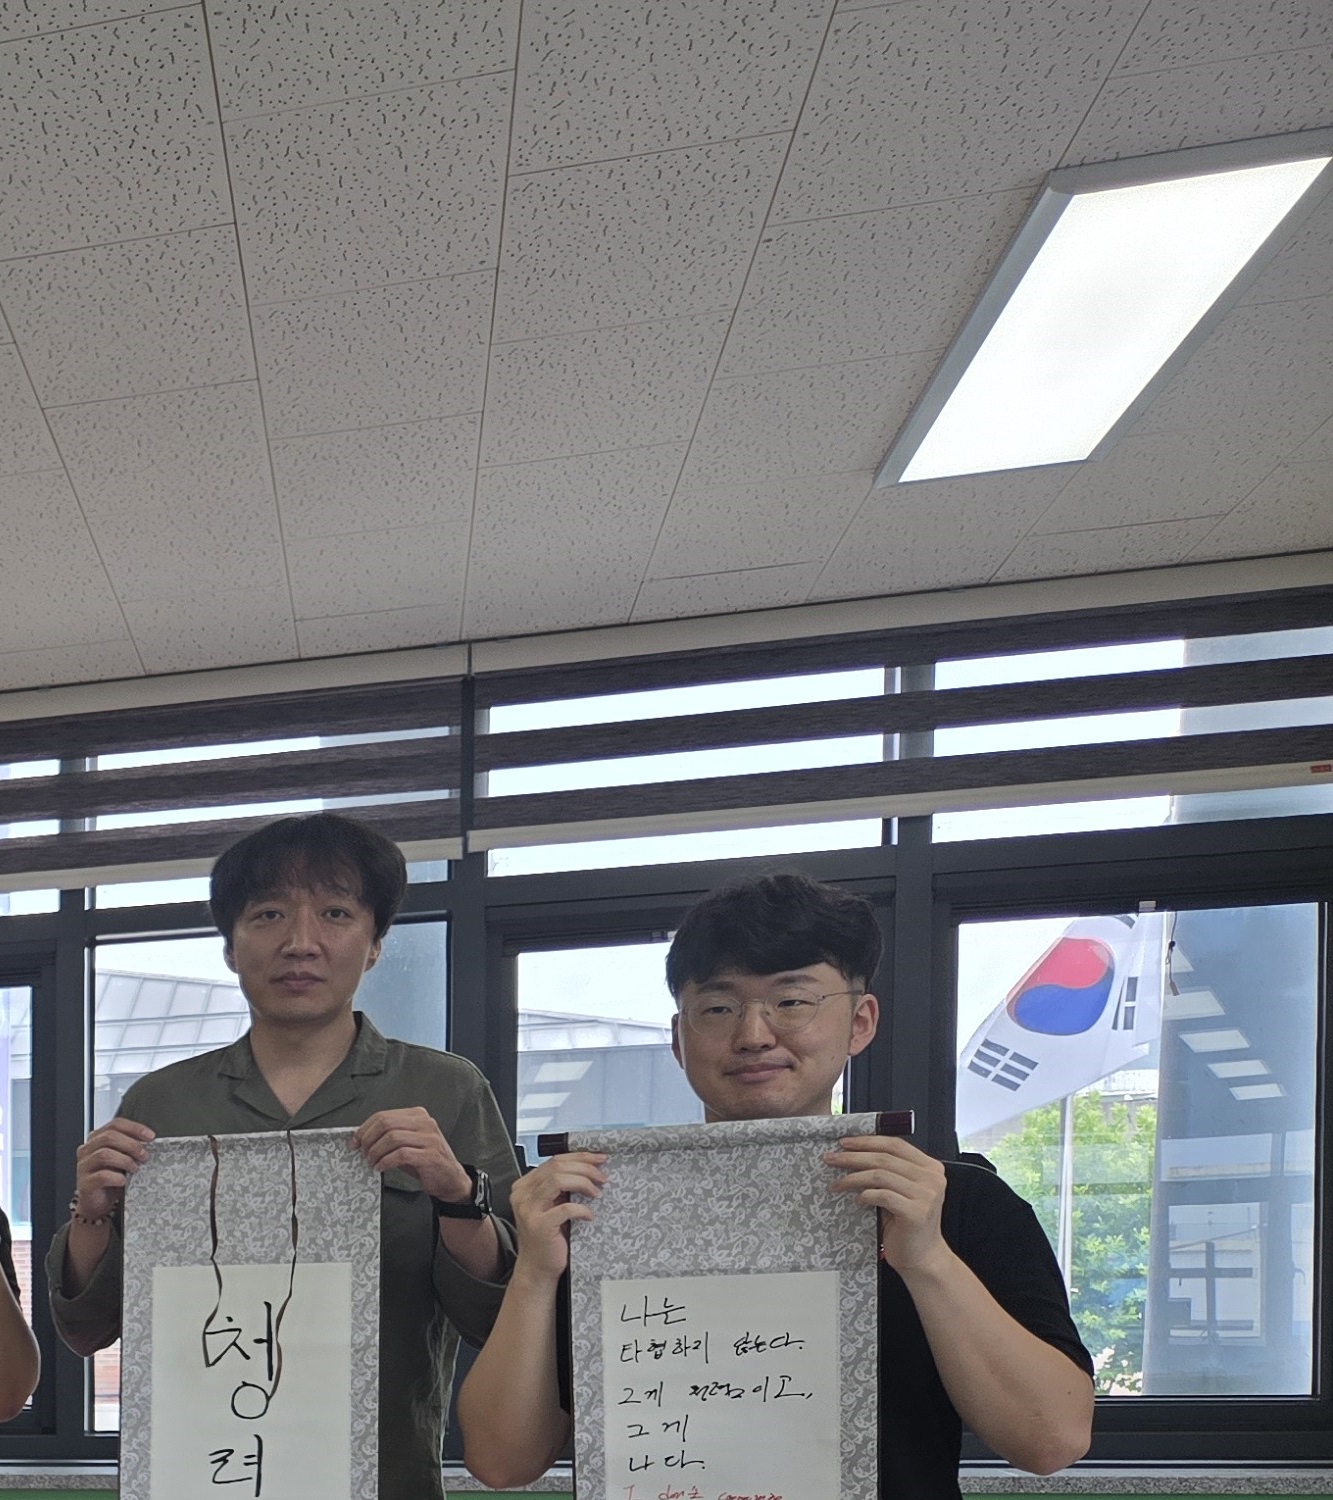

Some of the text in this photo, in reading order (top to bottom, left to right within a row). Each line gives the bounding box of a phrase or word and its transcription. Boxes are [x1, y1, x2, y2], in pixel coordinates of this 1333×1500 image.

[620, 1295, 687, 1327] 나는
[616, 1380, 664, 1408] 그게
[626, 1413, 690, 1443] 그게
[657, 1483, 705, 1500] don't
